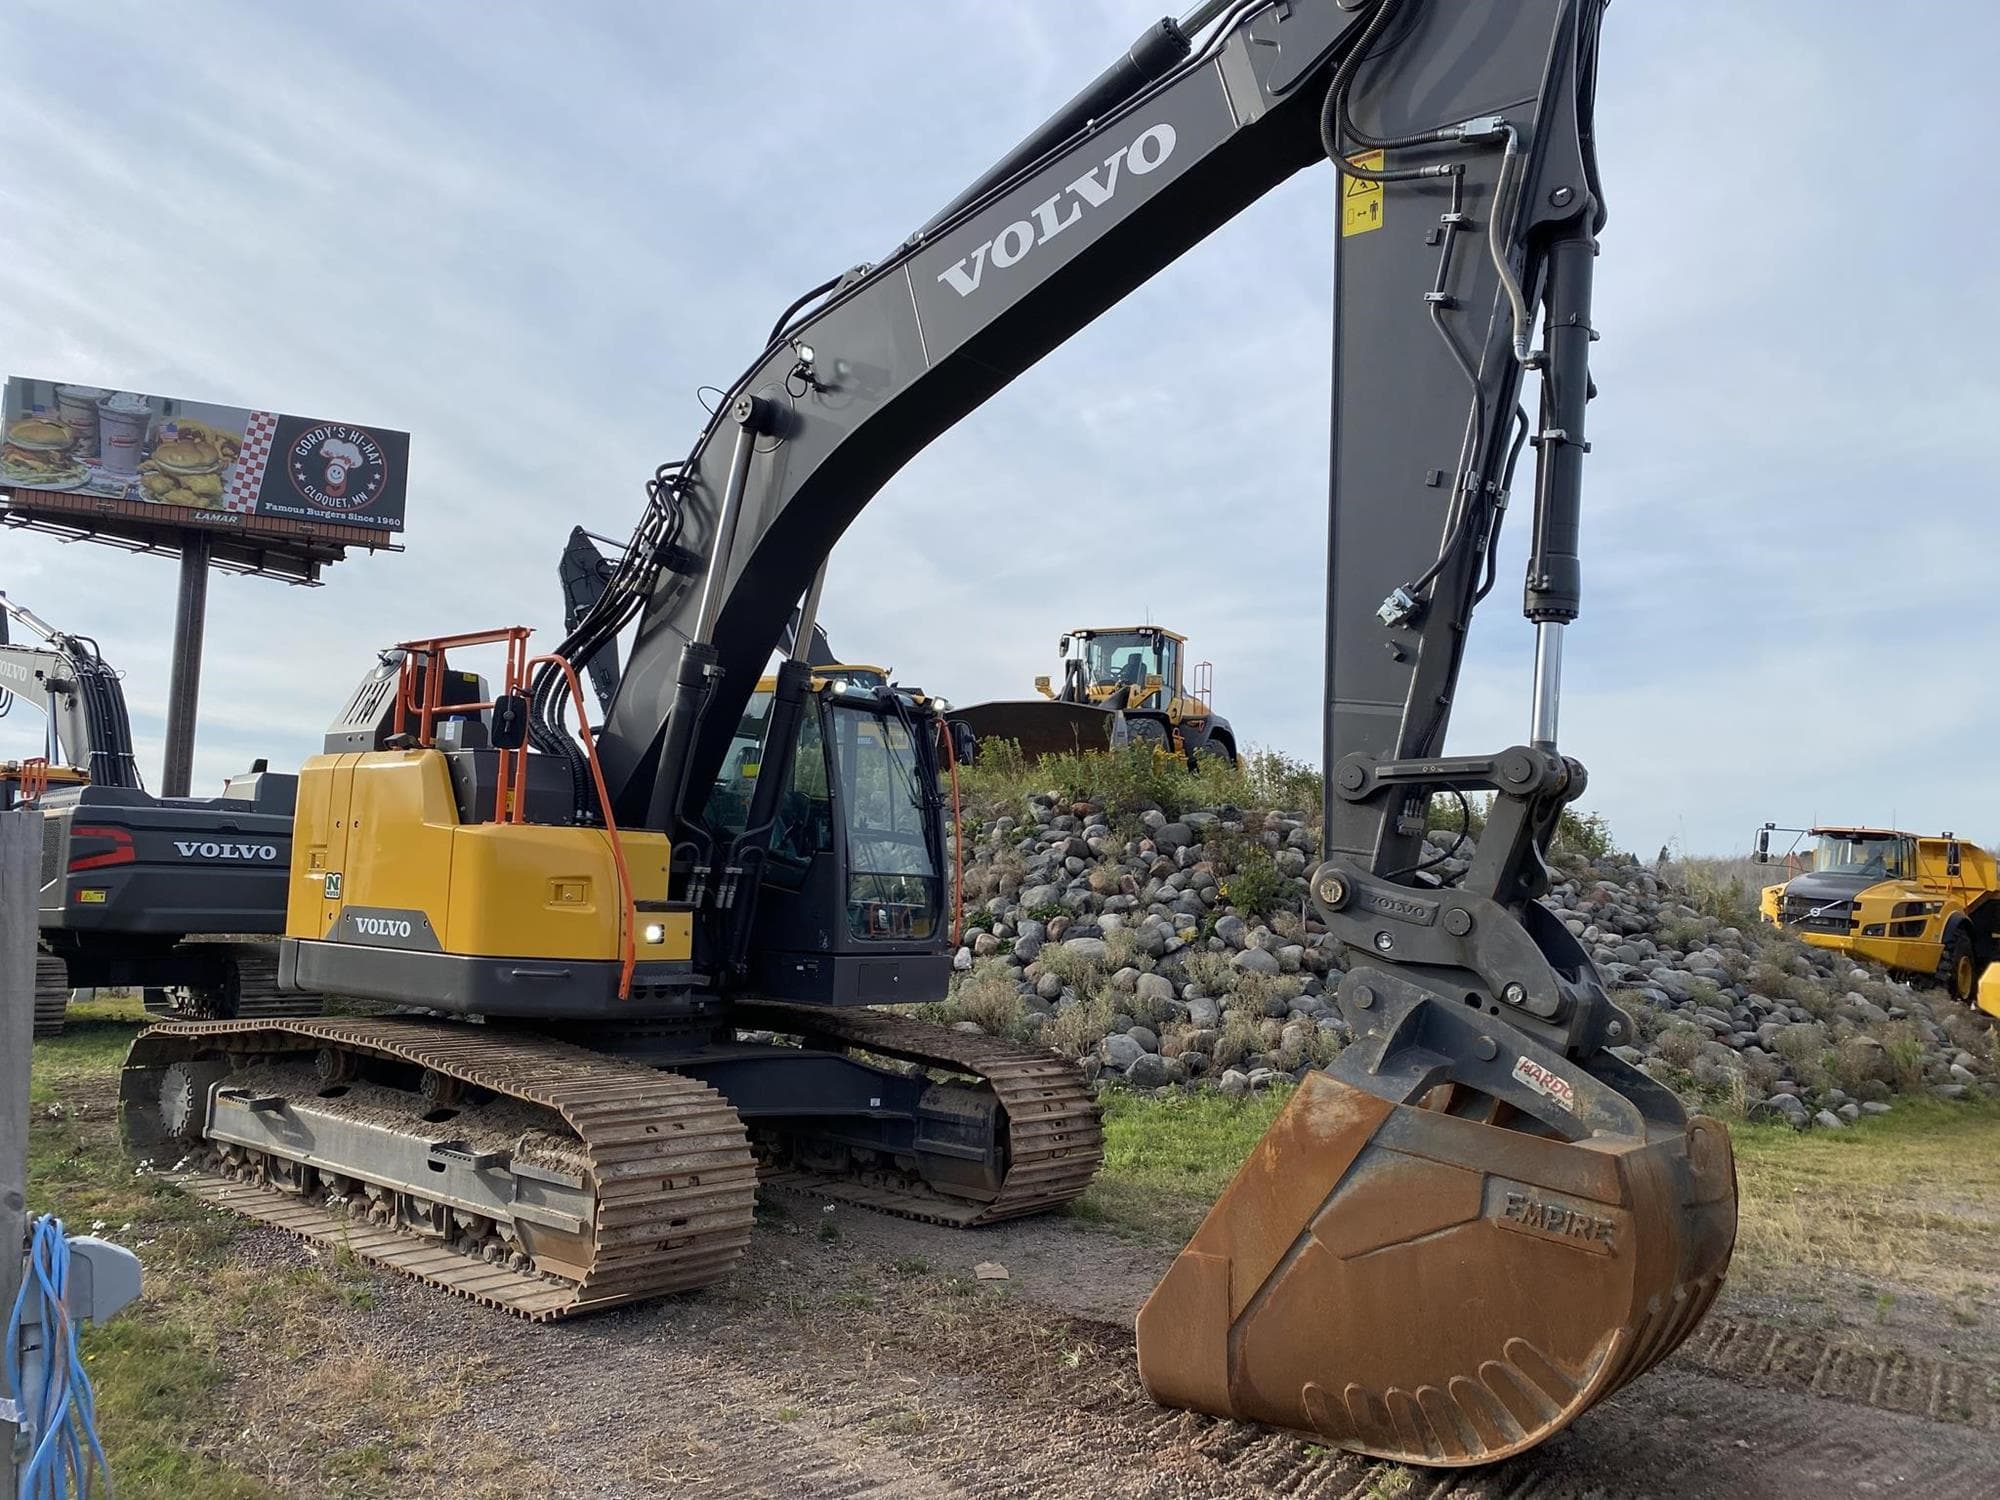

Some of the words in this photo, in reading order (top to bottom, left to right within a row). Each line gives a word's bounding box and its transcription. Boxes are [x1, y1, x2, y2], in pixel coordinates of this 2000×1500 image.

[937, 123, 1177, 297] VOLVO
[295, 426, 346, 456] GORDY'S
[349, 430, 383, 465] HI-HAT
[304, 485, 351, 508] CLOQUET,
[351, 491, 369, 505] MN
[195, 511, 239, 524] LAMAR
[265, 502, 305, 515] Famous
[306, 507, 347, 520] Burgers
[347, 513, 375, 524] Since
[0, 660, 27, 682] OLVO
[174, 841, 277, 860] VOLVO
[326, 875, 340, 891] N
[355, 917, 411, 937] VOLVO
[1519, 1060, 1574, 1100] HARDO
[1506, 1192, 1616, 1244] EMPIRE
